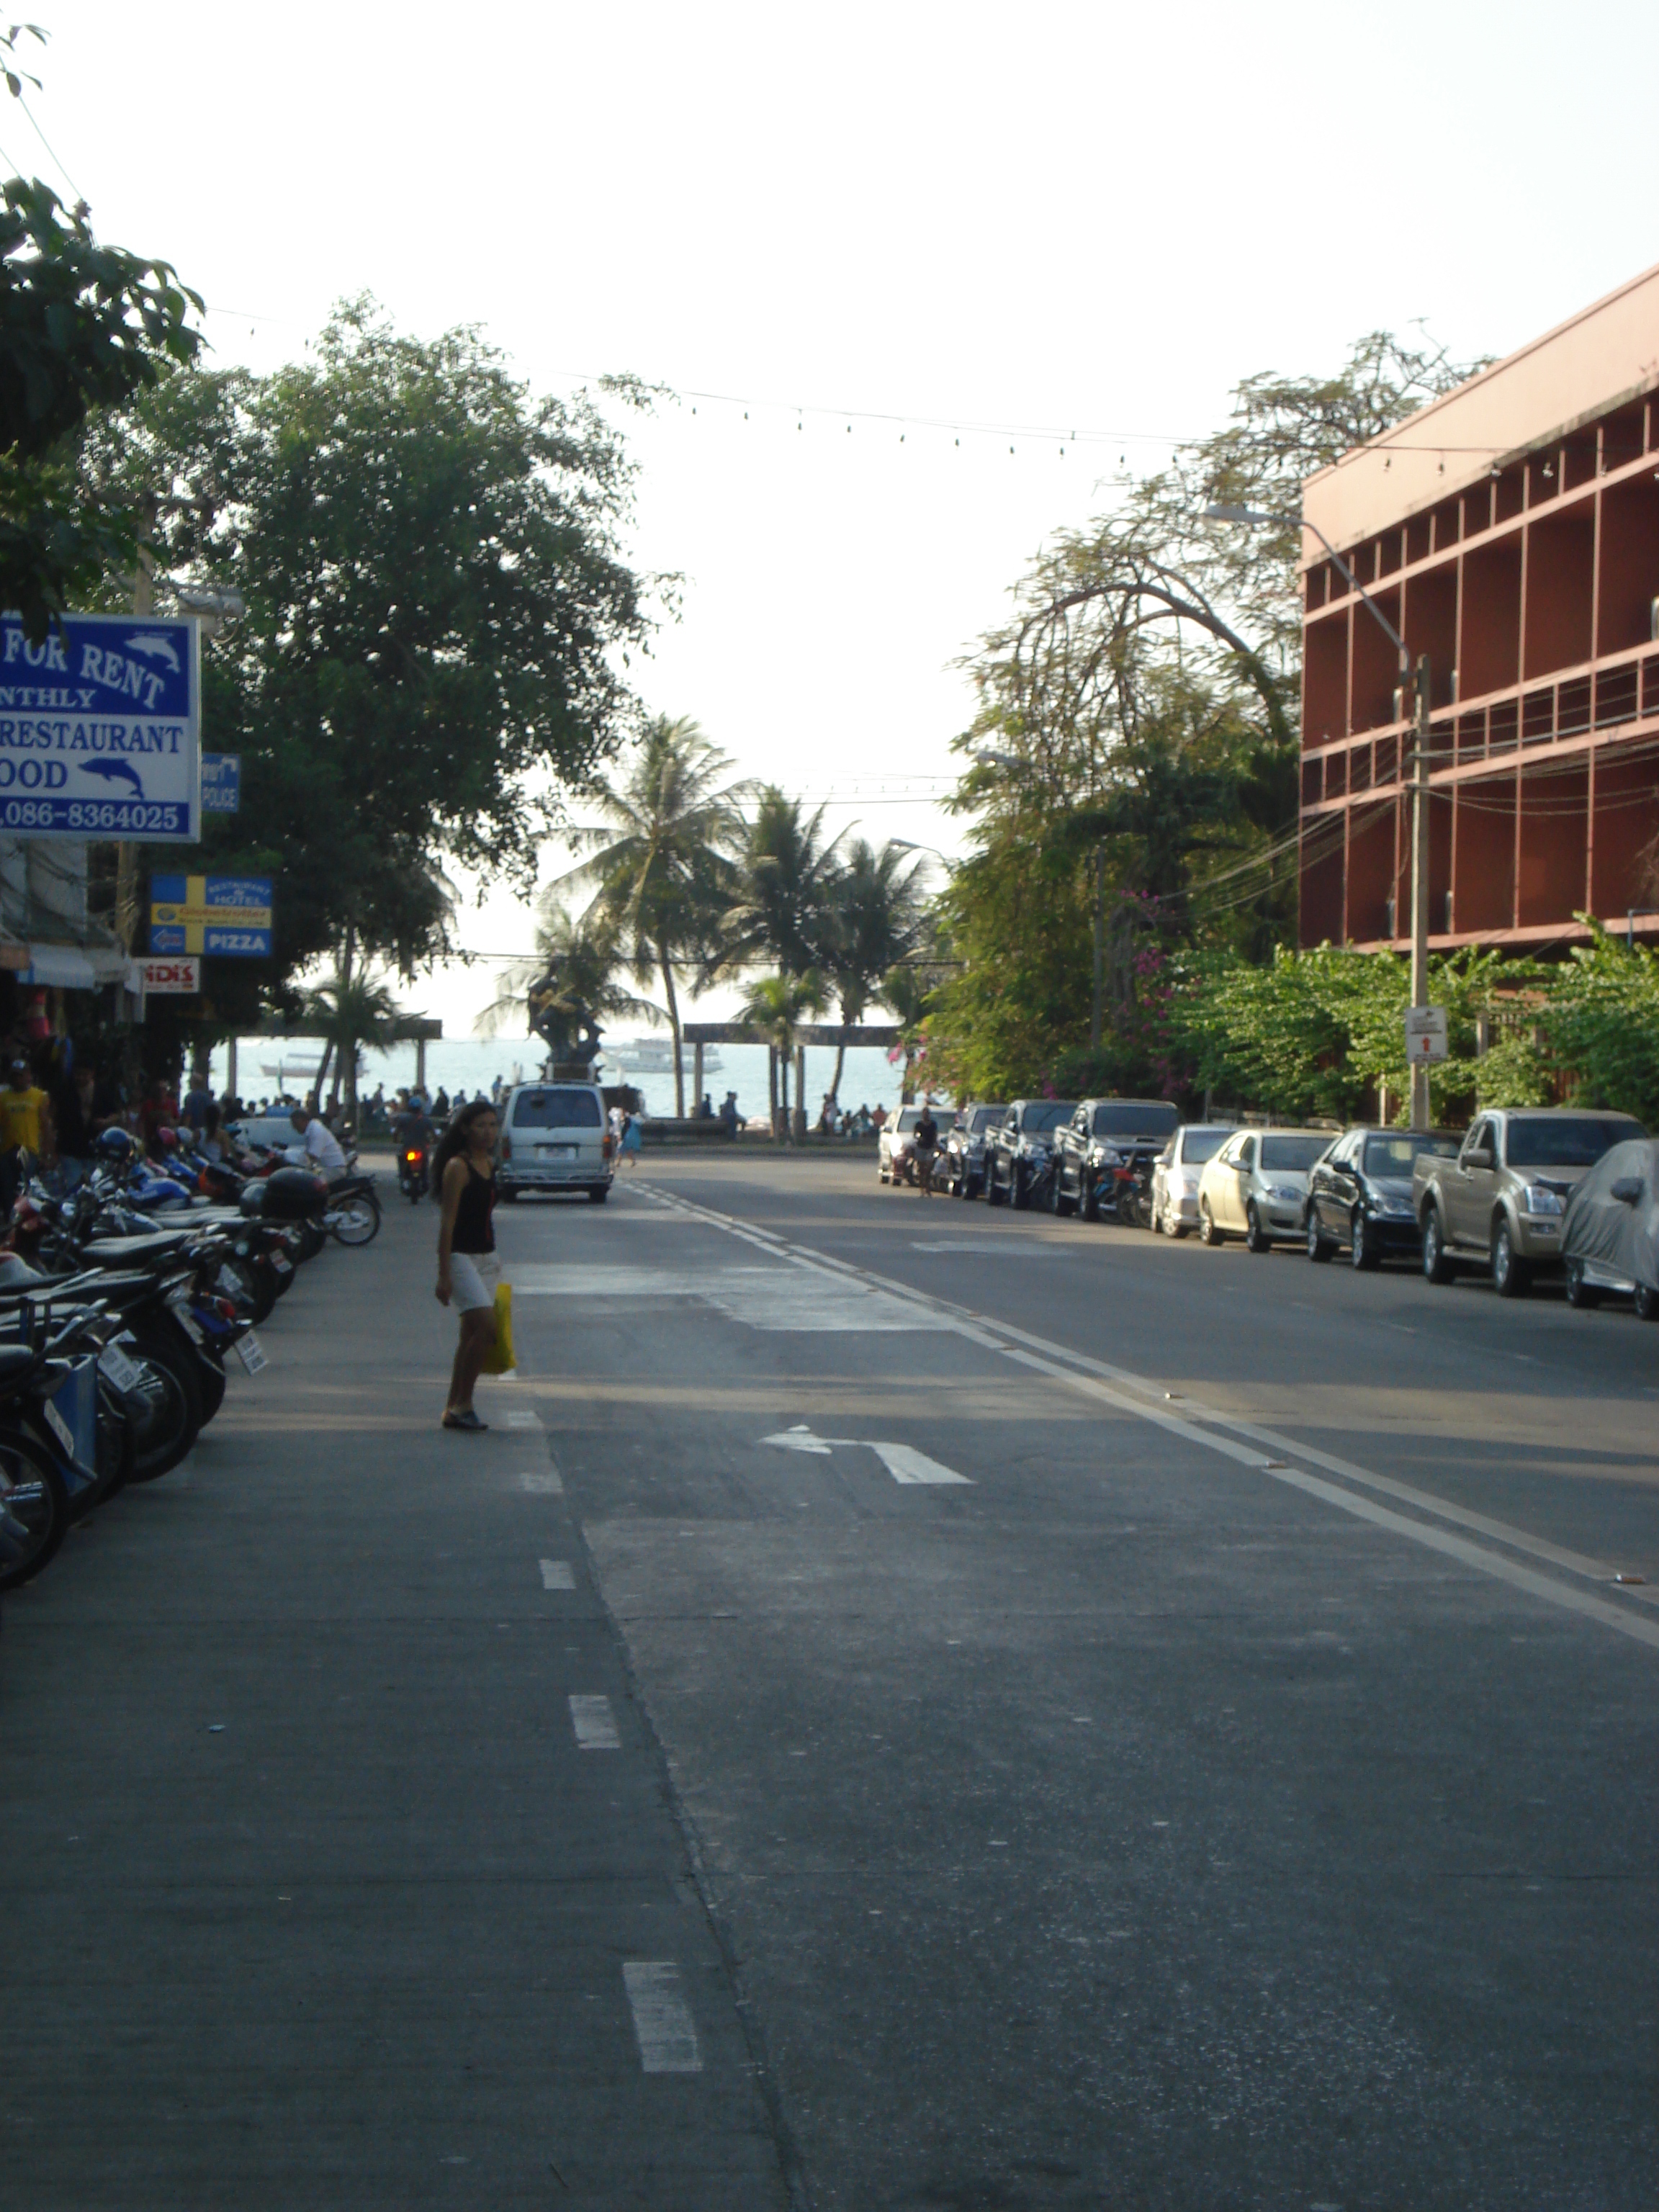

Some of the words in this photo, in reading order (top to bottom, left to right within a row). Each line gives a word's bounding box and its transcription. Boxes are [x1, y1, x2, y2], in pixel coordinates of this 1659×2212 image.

[4, 628, 68, 673] FOR
[79, 643, 165, 710] RENT
[0, 686, 97, 709] NTHLY
[0, 720, 184, 754] RESTAURANT
[209, 933, 266, 951] PIZZA
